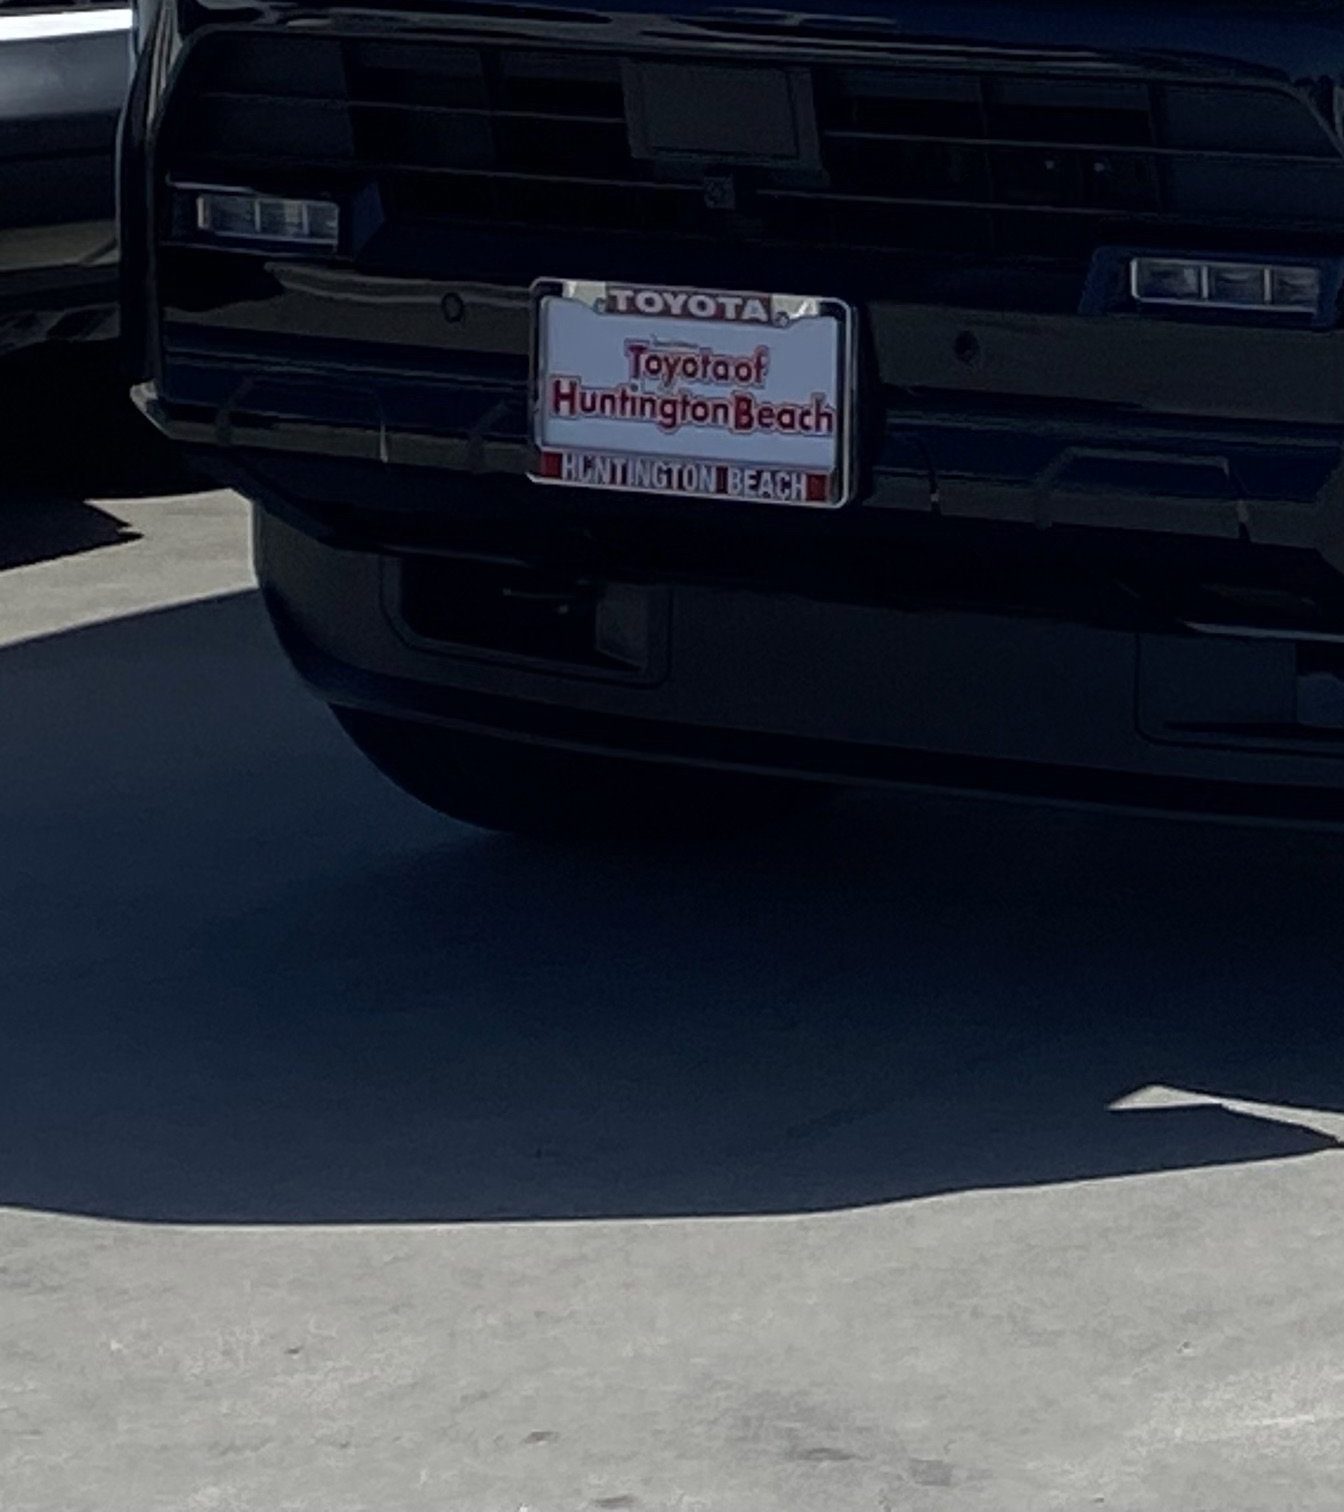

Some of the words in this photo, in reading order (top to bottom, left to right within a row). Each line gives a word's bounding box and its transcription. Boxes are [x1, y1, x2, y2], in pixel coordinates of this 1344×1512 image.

[612, 290, 768, 323] TOYOTA
[627, 343, 730, 385] Toyota
[733, 344, 770, 386] of
[551, 377, 731, 431] Huntington
[733, 392, 834, 433] Beach
[561, 452, 717, 495] HUNTINGTON
[729, 468, 807, 502] BEACH
